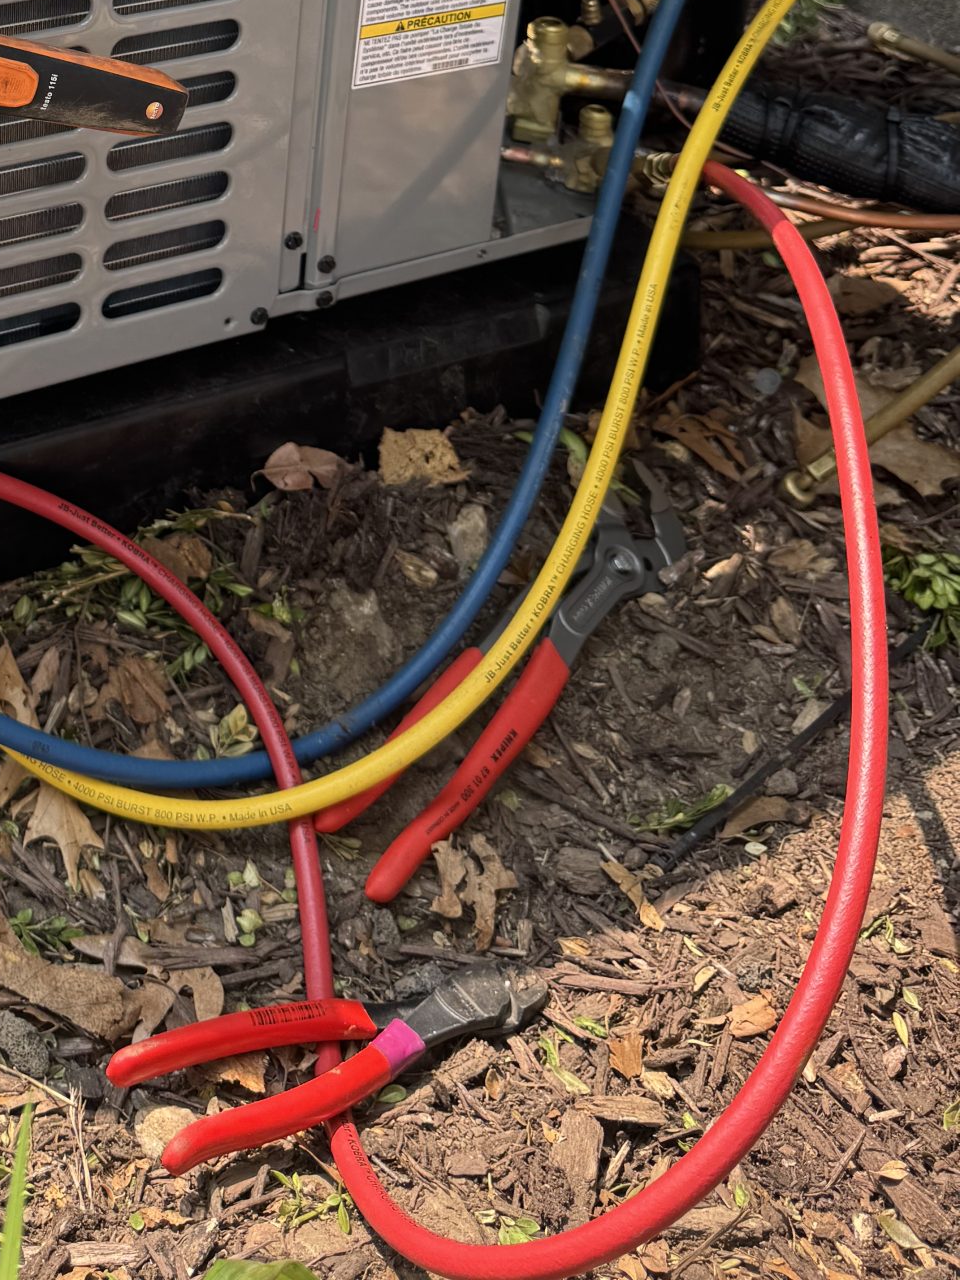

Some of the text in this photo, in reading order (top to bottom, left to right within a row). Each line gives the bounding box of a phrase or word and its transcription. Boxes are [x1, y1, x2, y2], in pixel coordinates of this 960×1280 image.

[407, 10, 472, 29] PRÉCAUTION
[40, 73, 59, 110] testo 115i
[647, 283, 658, 301] USA
[638, 312, 650, 338] Made
[624, 364, 635, 386] PSI
[619, 383, 631, 405] 800
[609, 405, 625, 441] BURST
[603, 441, 615, 460] PSI
[595, 459, 609, 483] 4000
[485, 650, 513, 684] JB-Just
[510, 624, 531, 652] Better
[556, 522, 586, 575] CHARGING
[584, 491, 599, 521] HOSE
[58, 502, 90, 524] JB-Just
[91, 520, 116, 539] Better
[158, 567, 197, 610] CHARGING
[276, 727, 288, 746] PSI
[491, 728, 518, 762] KNIPEX
[40, 760, 67, 783] HOSE
[72, 780, 96, 799] 4000
[97, 790, 114, 806] PSI
[116, 798, 152, 817] BURST
[154, 808, 173, 821] 800
[175, 810, 193, 823] PSI
[194, 812, 219, 824] W.P.
[229, 810, 256, 823] Made
[270, 802, 292, 817] USA
